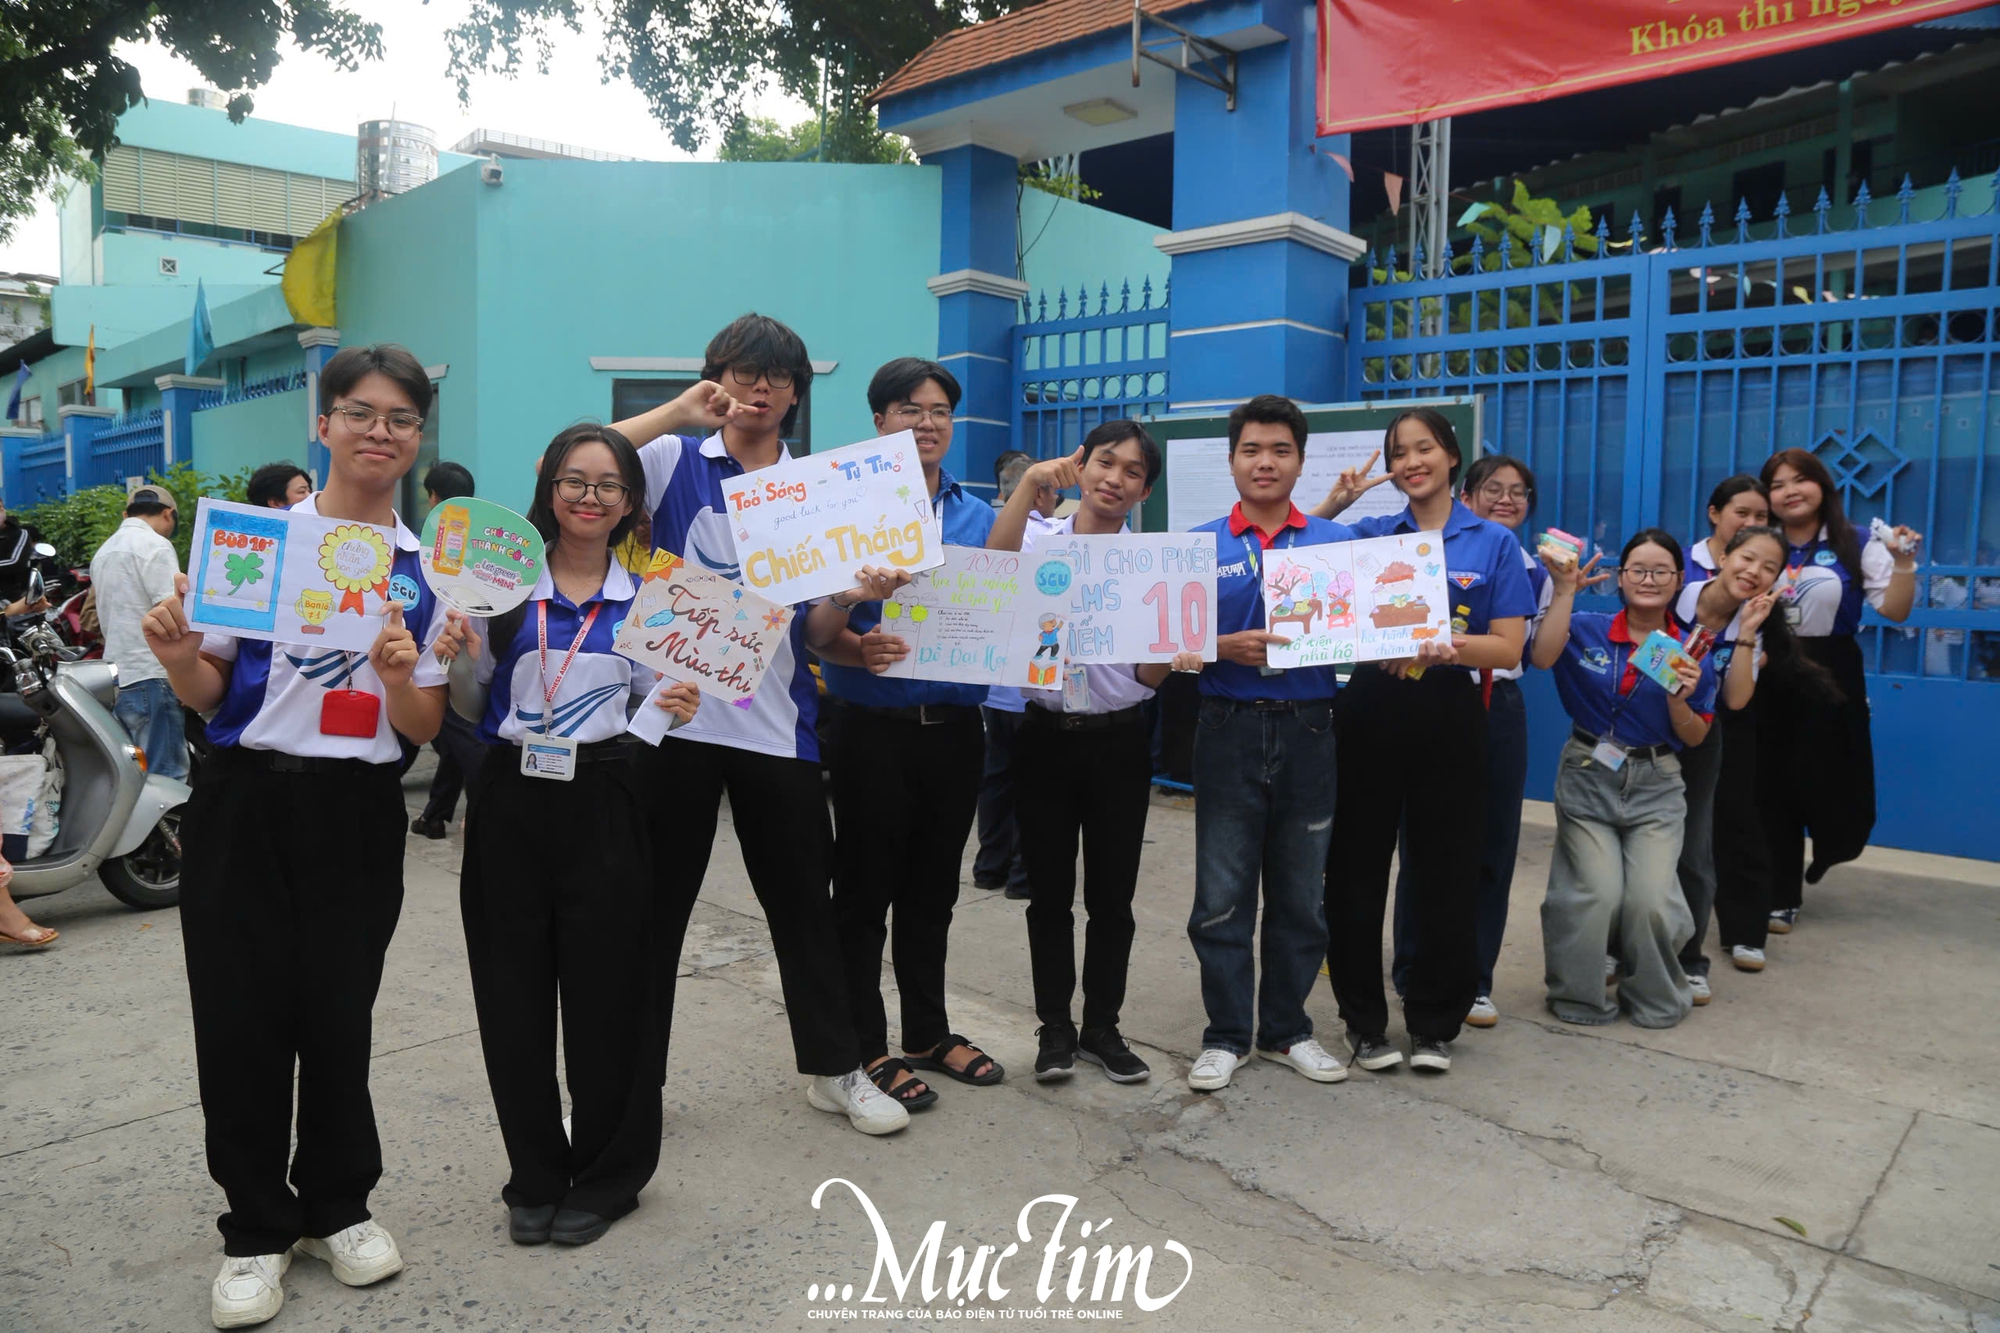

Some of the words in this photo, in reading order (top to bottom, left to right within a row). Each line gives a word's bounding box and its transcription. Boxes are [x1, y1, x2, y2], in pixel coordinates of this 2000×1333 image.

[1628, 14, 1726, 56] Khóa
[1737, 0, 1795, 32] thi
[765, 481, 807, 503] Sáng
[838, 460, 862, 482] Tự
[773, 510, 797, 530] good
[799, 504, 822, 518] luck
[826, 500, 838, 509] for
[841, 497, 858, 510] you
[213, 529, 249, 549] Bùa
[484, 526, 510, 540] CHÚC
[470, 538, 507, 555] THÀNH
[505, 547, 536, 569] CÔNG
[655, 551, 671, 564] 10
[745, 535, 827, 589] Chiến
[825, 514, 925, 567] Thắng
[1103, 548, 1154, 575] CHO
[1162, 538, 1217, 574] PHÉP
[391, 581, 417, 601] SGU
[1038, 571, 1069, 587] SGU
[667, 583, 721, 640] Tiếp
[724, 627, 764, 654] sức
[1142, 581, 1208, 654] 10
[1306, 635, 1333, 648] tiên
[1333, 640, 1354, 661] hộ
[546, 675, 563, 703] BUSINESS
[559, 628, 587, 675] ADMINISTRATION
[645, 631, 713, 677] Mùa
[714, 662, 752, 693] thi
